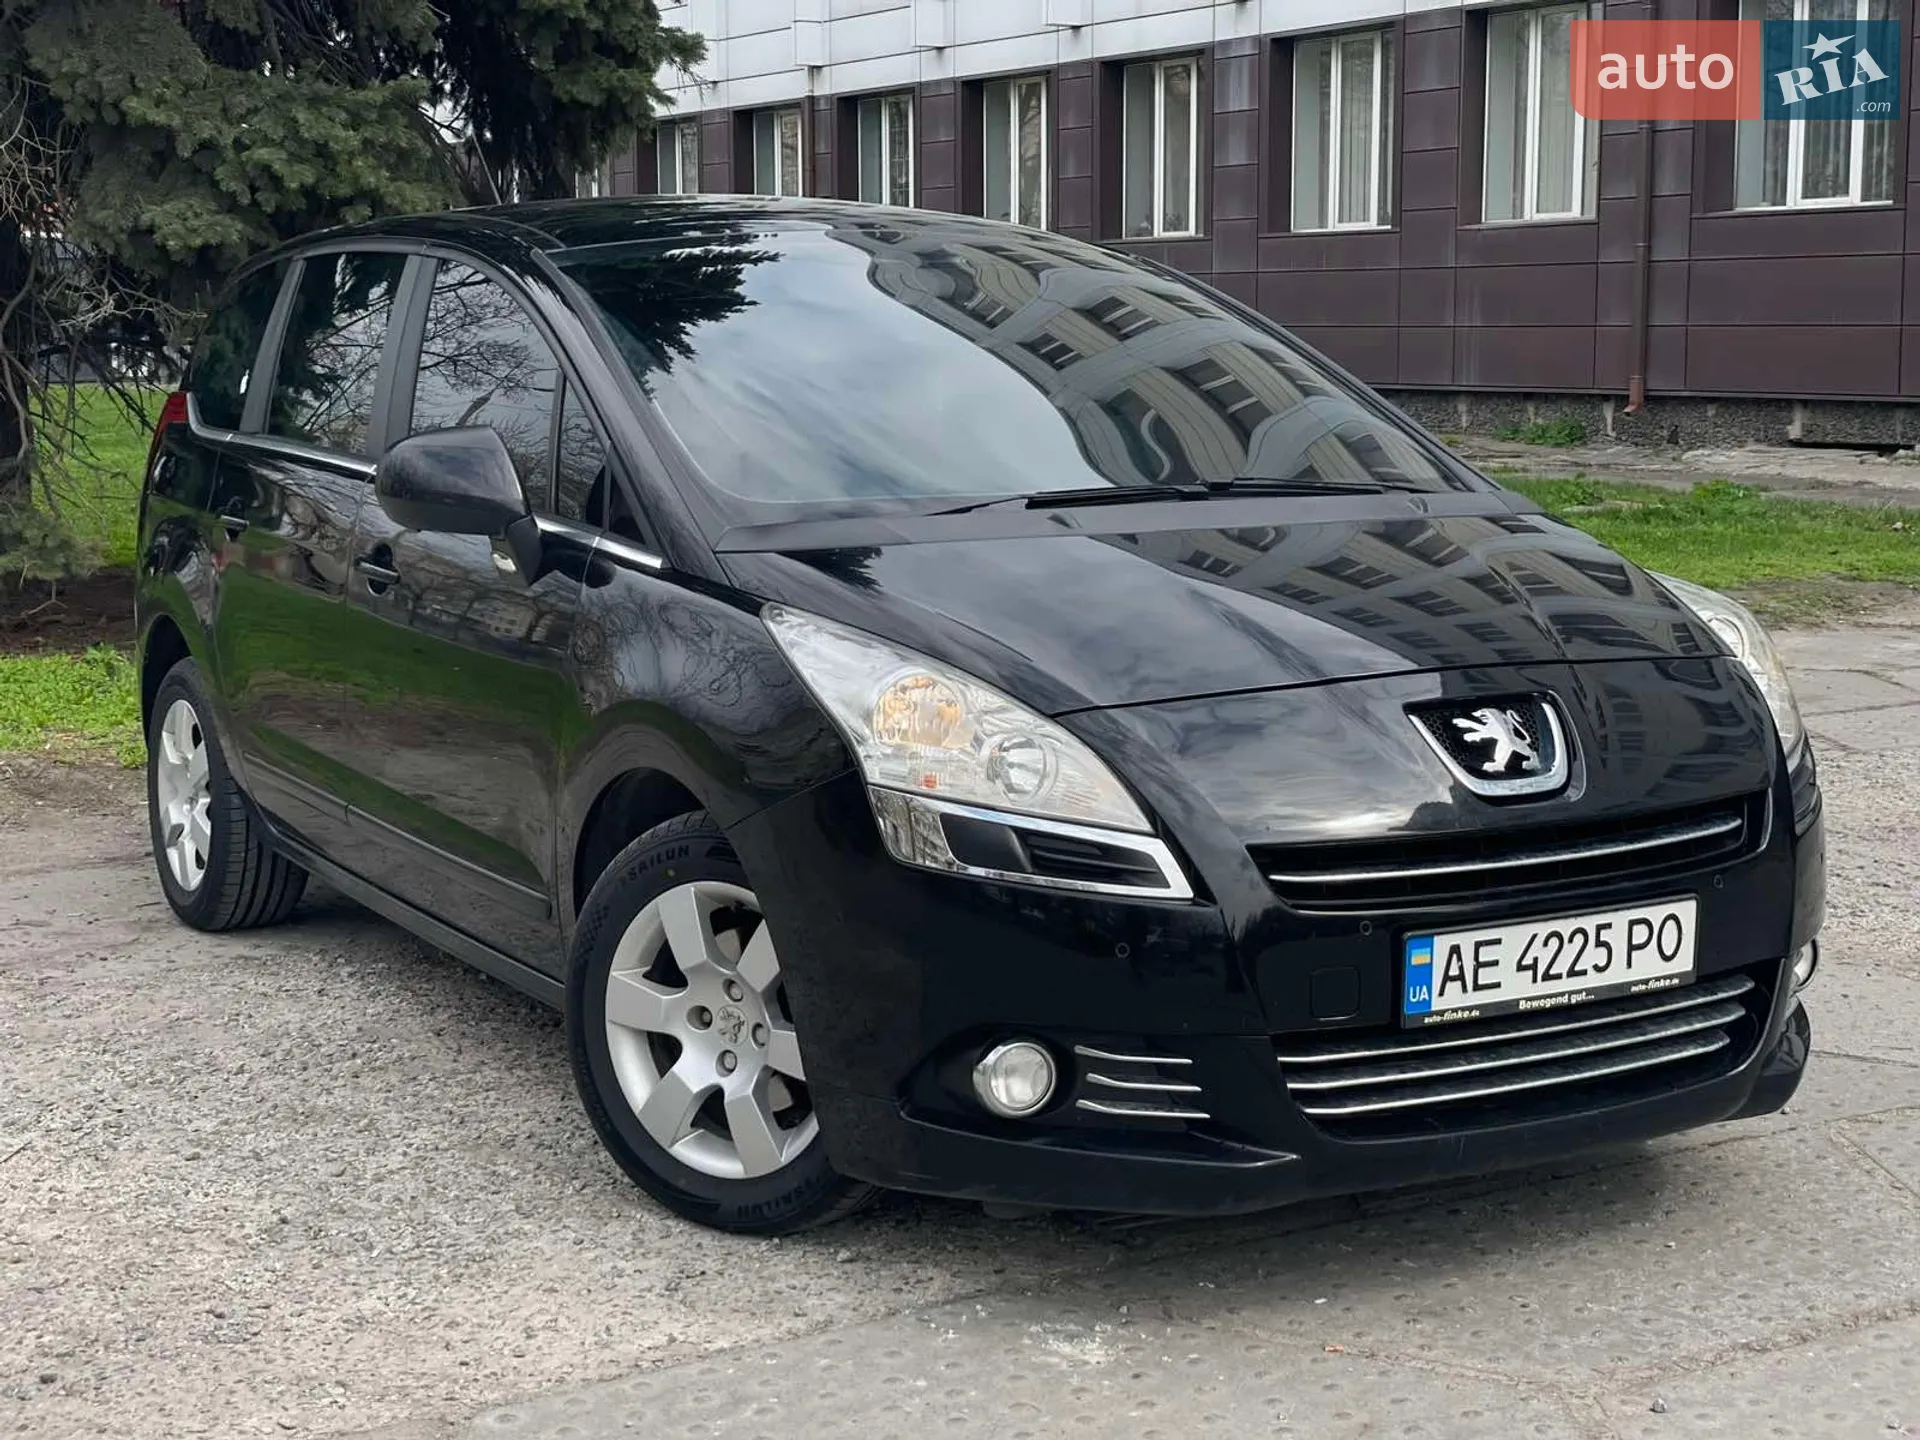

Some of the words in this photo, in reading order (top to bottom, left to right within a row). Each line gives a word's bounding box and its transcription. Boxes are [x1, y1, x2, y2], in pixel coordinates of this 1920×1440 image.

[627, 845, 691, 881] SAILUN
[1437, 938, 1502, 997] AE
[1515, 921, 1613, 984] 4225
[1626, 912, 1683, 969] PO
[1409, 984, 1430, 1003] UA
[1519, 993, 1569, 1009] Bewegend
